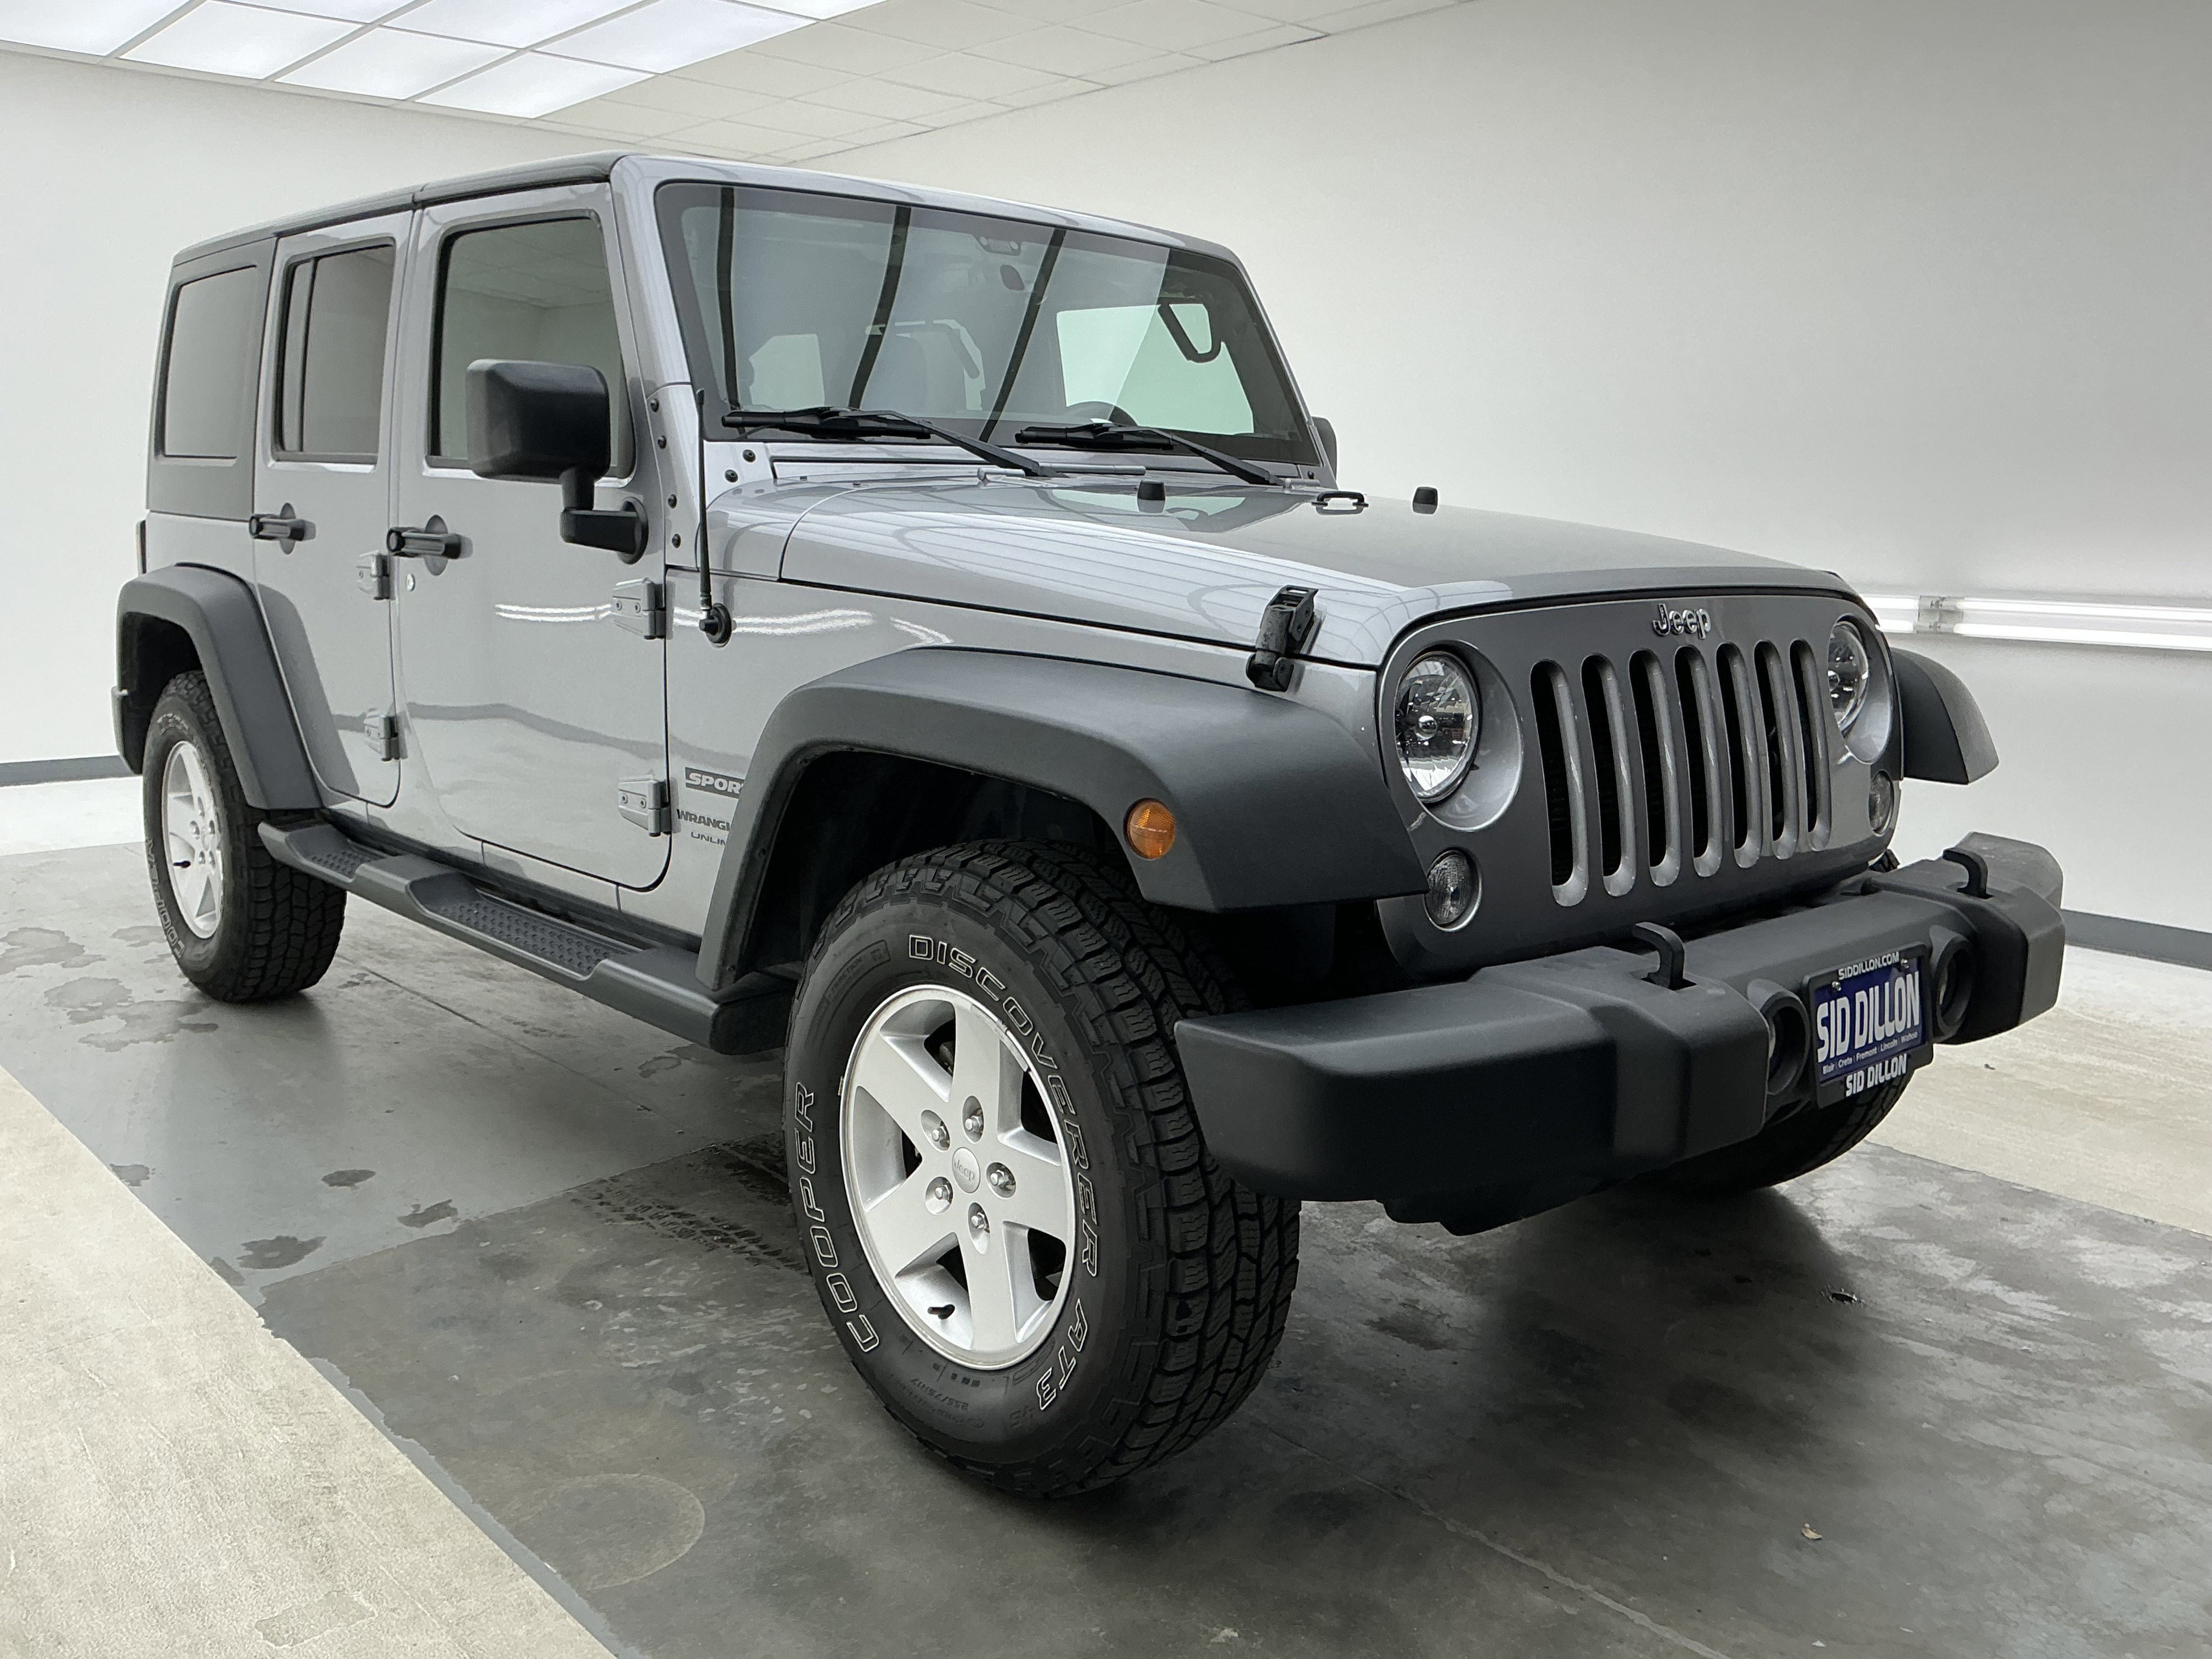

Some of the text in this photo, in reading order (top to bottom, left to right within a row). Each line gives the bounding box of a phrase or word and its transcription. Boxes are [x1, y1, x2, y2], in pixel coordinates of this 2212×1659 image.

[1652, 603, 1711, 640] Jeep
[686, 772, 744, 794] SPOR
[1838, 951, 1899, 980] SIDDILLON.COM
[1816, 970, 1920, 1063] SID DILLON
[1846, 1053, 1907, 1097] SID DILLON
[908, 934, 1098, 1278] DISCOVERER
[1036, 1298, 1088, 1410] AT3
[954, 1159, 975, 1181] Jeep
[794, 1082, 879, 1352] COOPER
